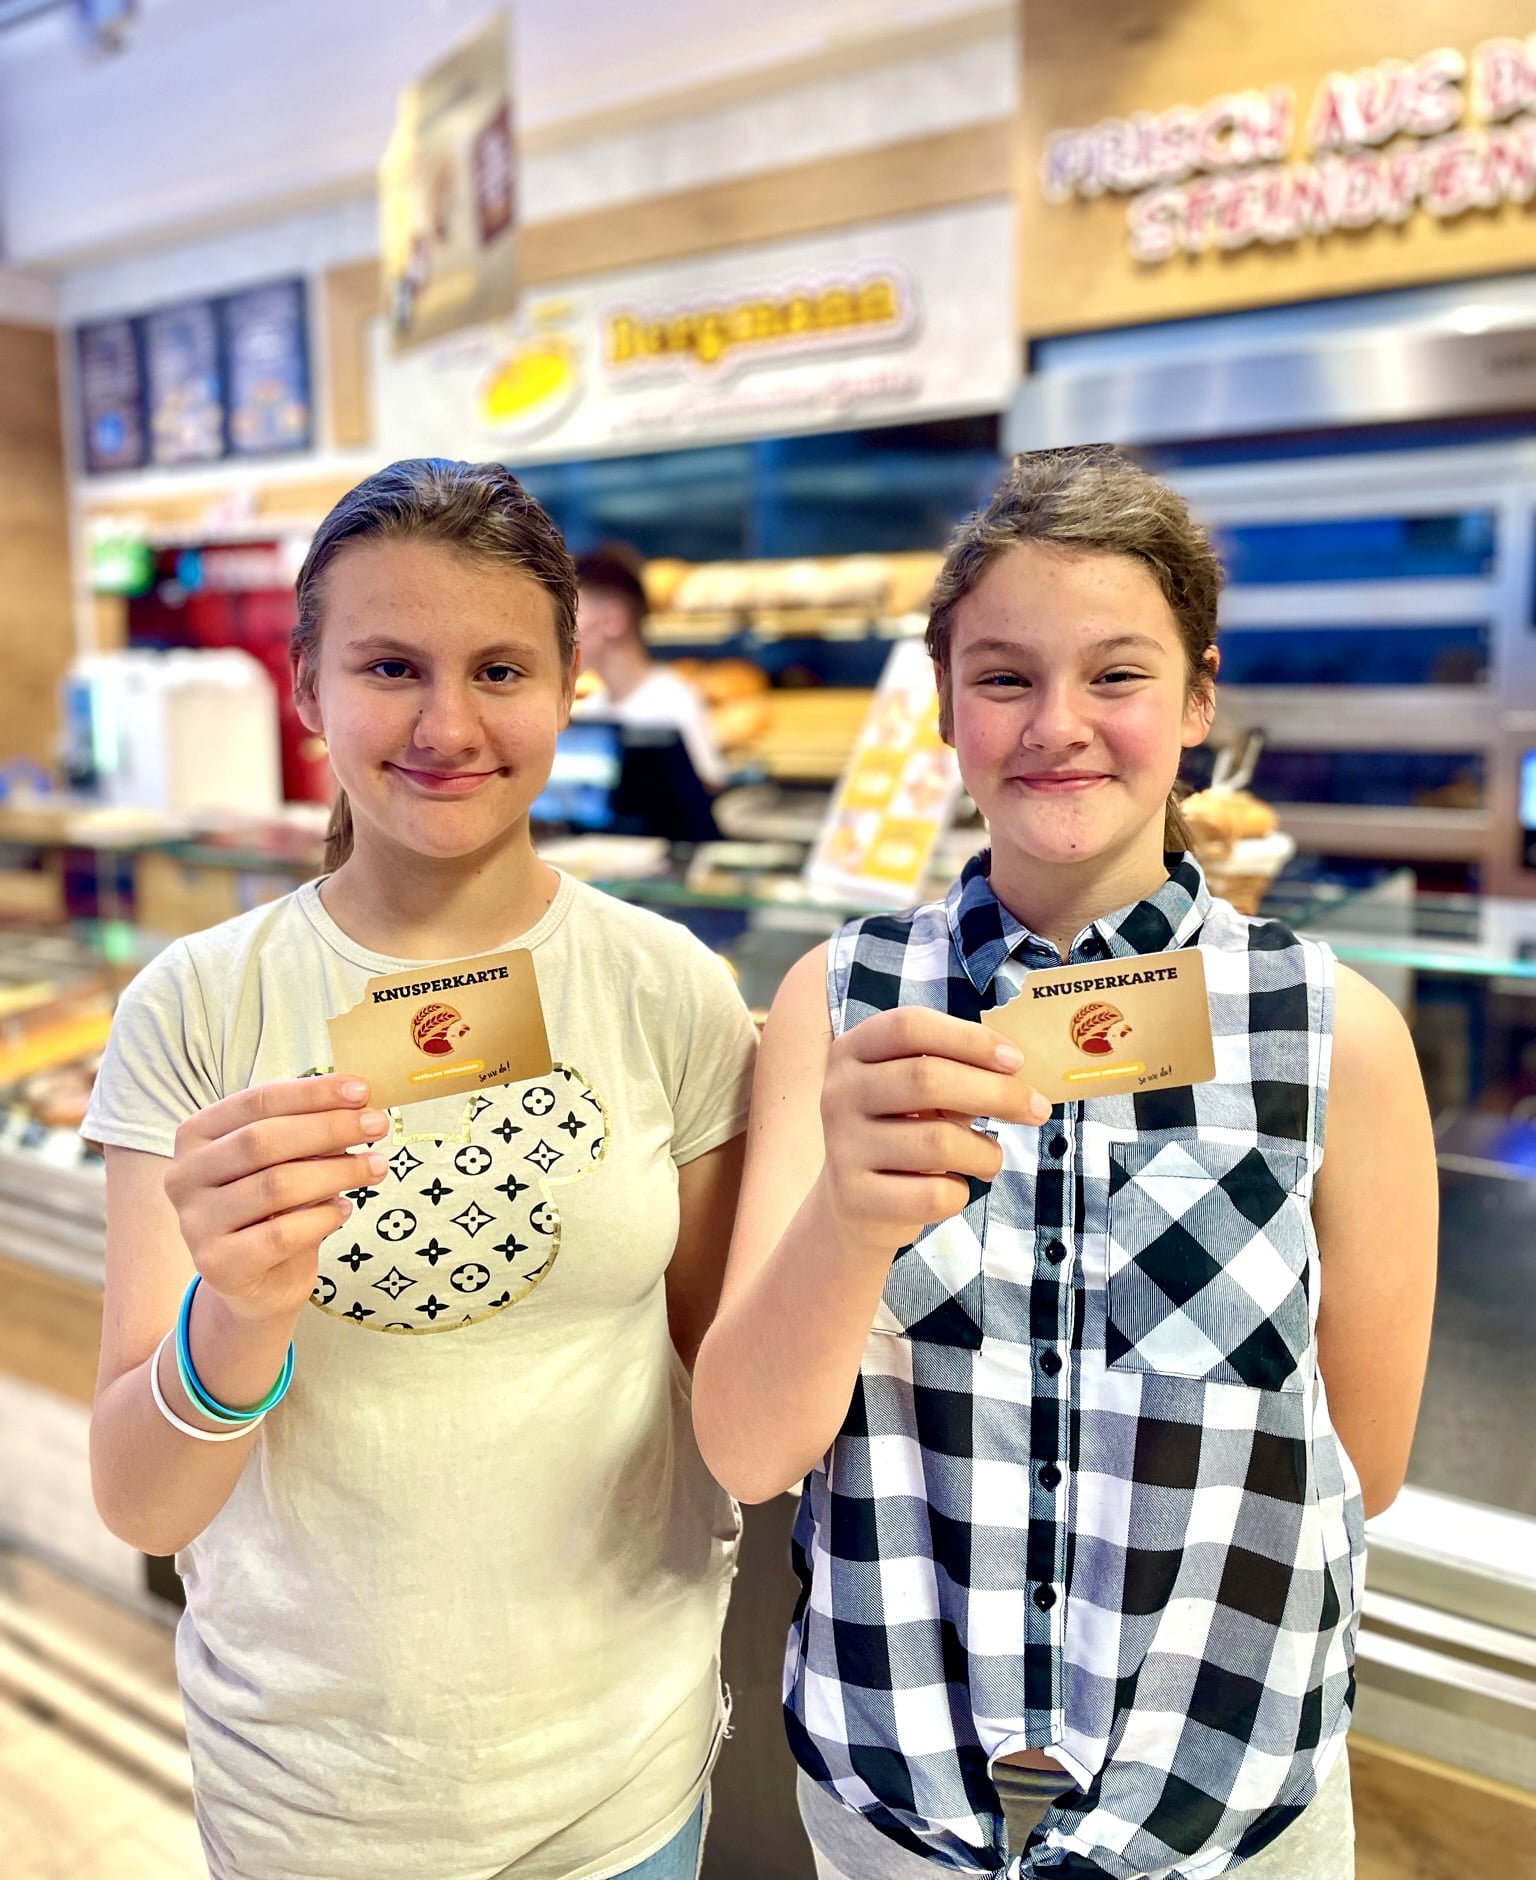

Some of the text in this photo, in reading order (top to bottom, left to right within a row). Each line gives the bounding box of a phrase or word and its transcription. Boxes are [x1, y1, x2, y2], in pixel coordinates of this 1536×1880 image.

[1045, 86, 1292, 201] FRISCH
[1309, 49, 1465, 154] AUS
[372, 966, 509, 1004] KNUSPERKARTE
[1032, 966, 1178, 1000] KNUSPERKARTE
